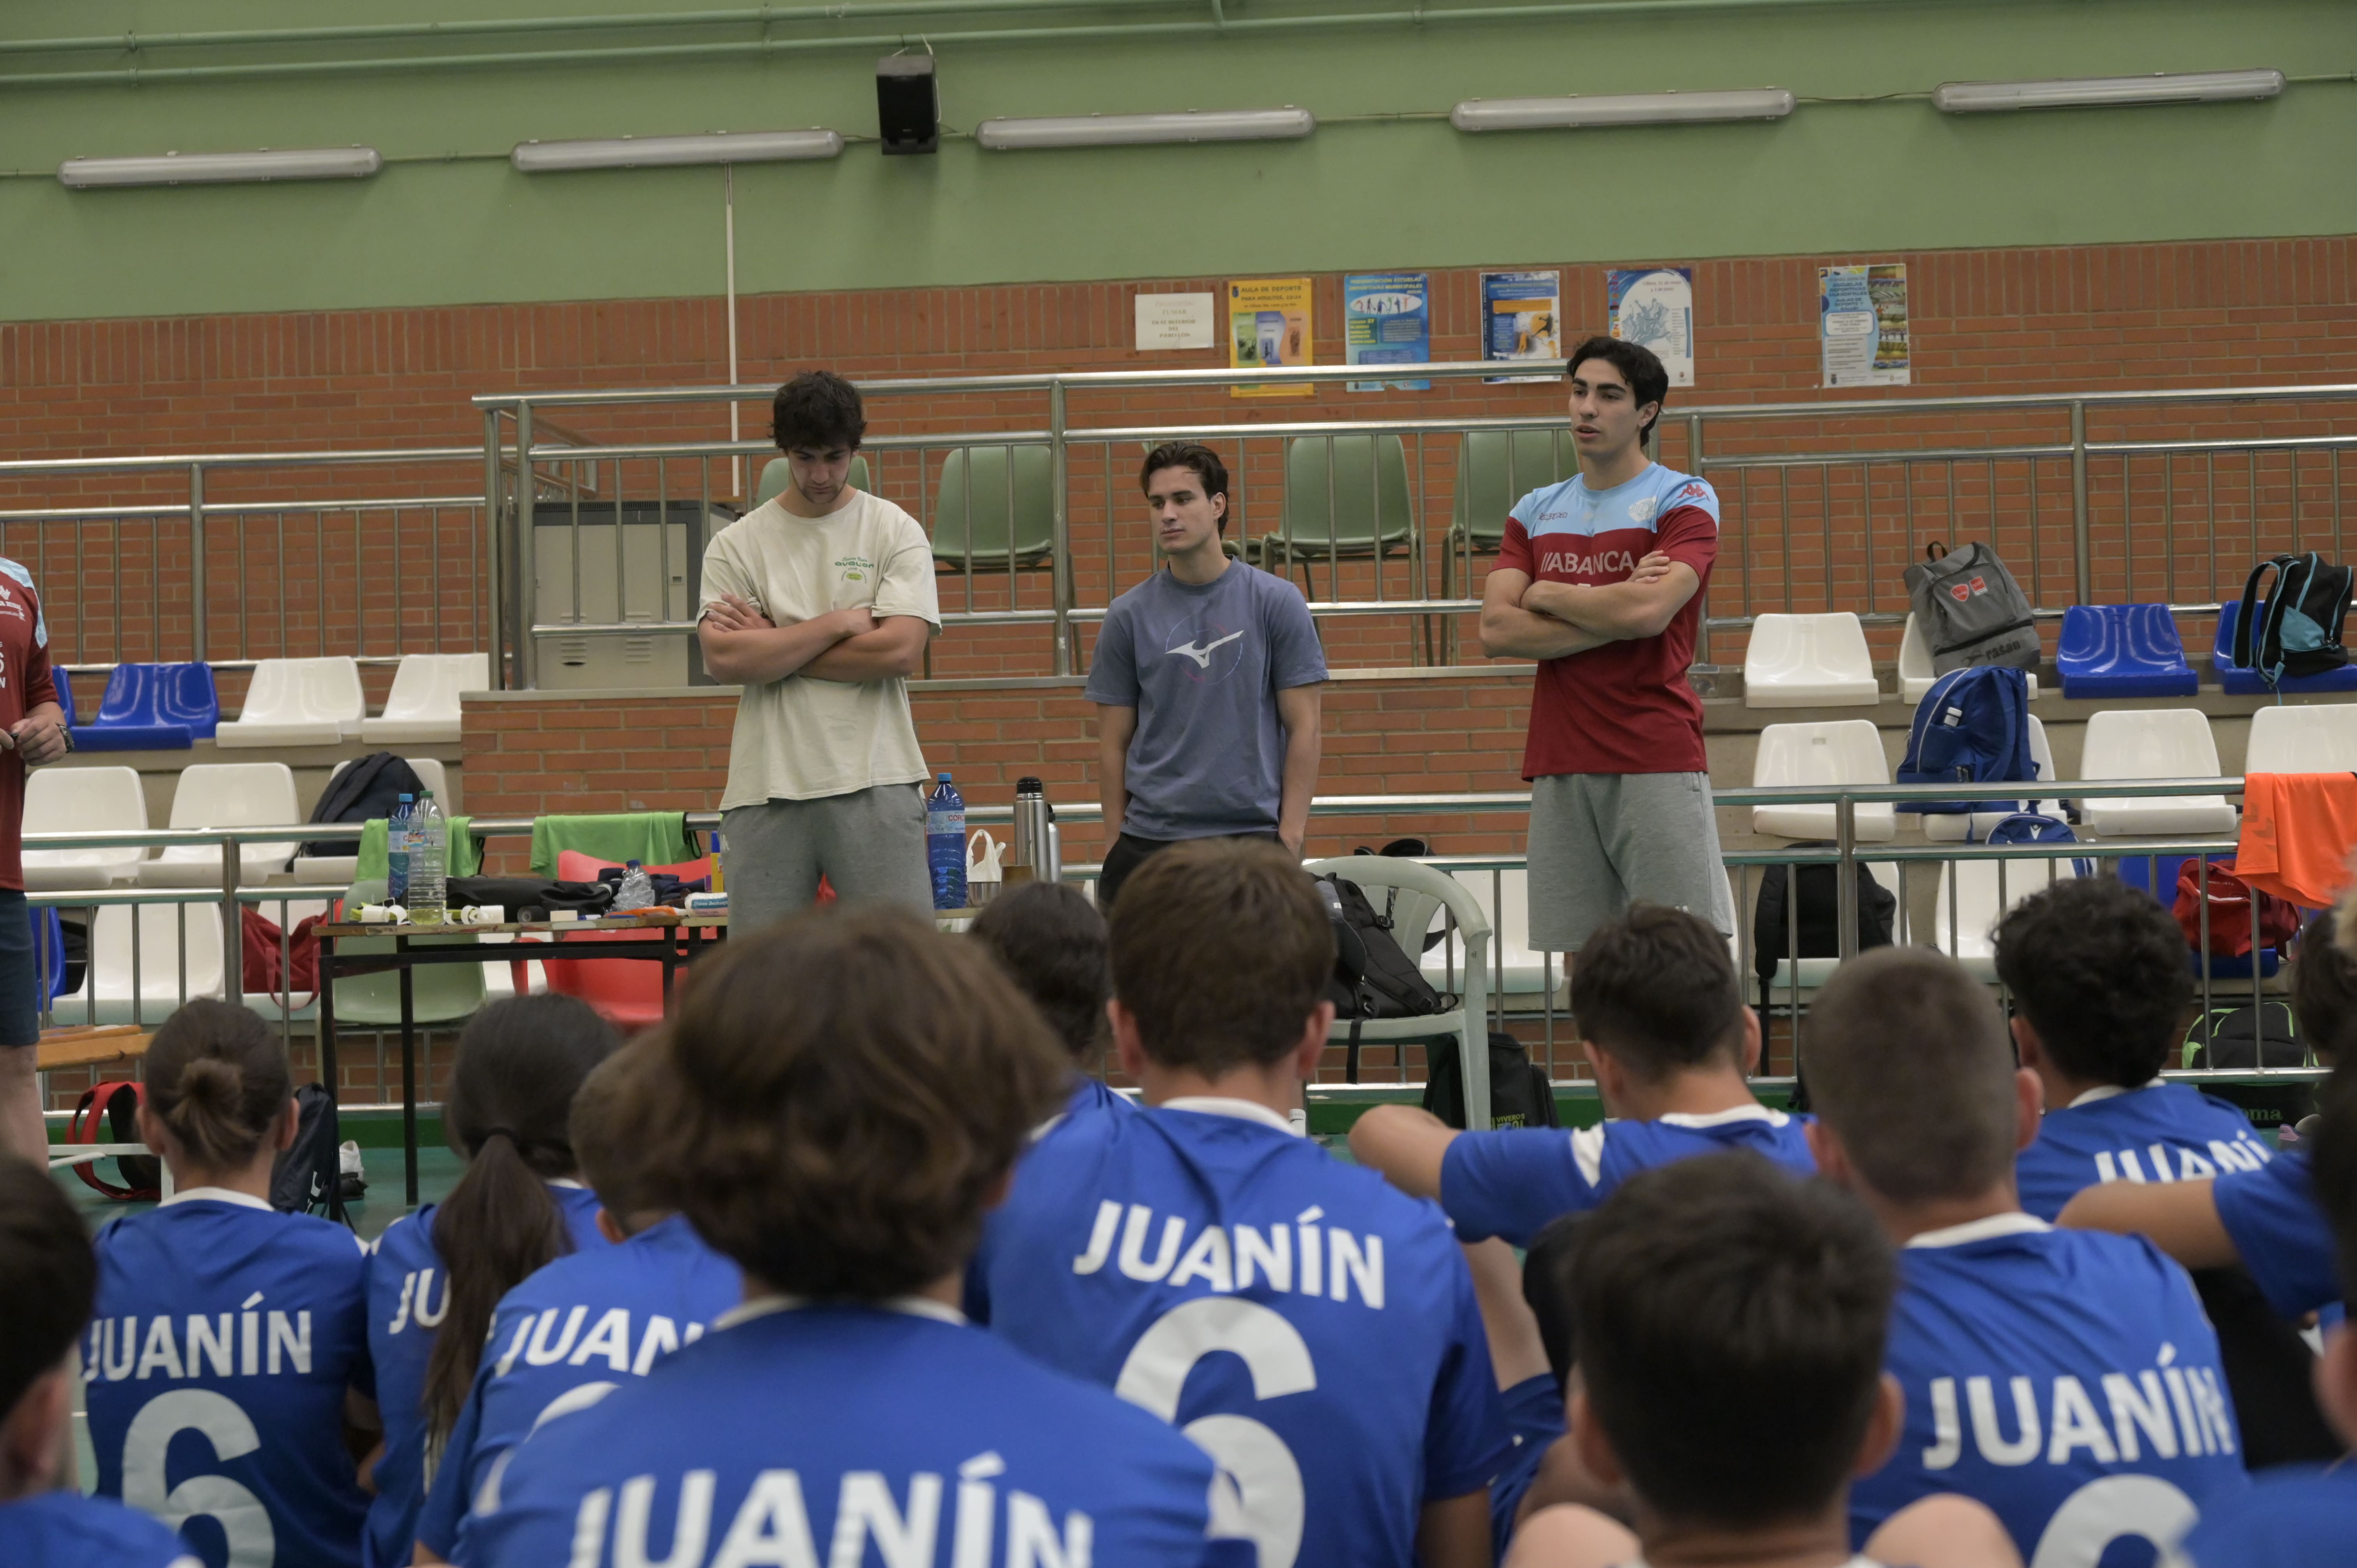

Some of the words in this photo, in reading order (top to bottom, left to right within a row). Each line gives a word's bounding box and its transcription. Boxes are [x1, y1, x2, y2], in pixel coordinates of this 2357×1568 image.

[1546, 551, 1636, 576] ABANCA
[1497, 1113, 1525, 1123] VIVEROS
[1072, 1199, 1385, 1310] JUANÍN
[82, 1291, 312, 1382] JUANÍN
[1922, 1341, 2236, 1470] JUANÍN
[121, 1388, 276, 1568] 6
